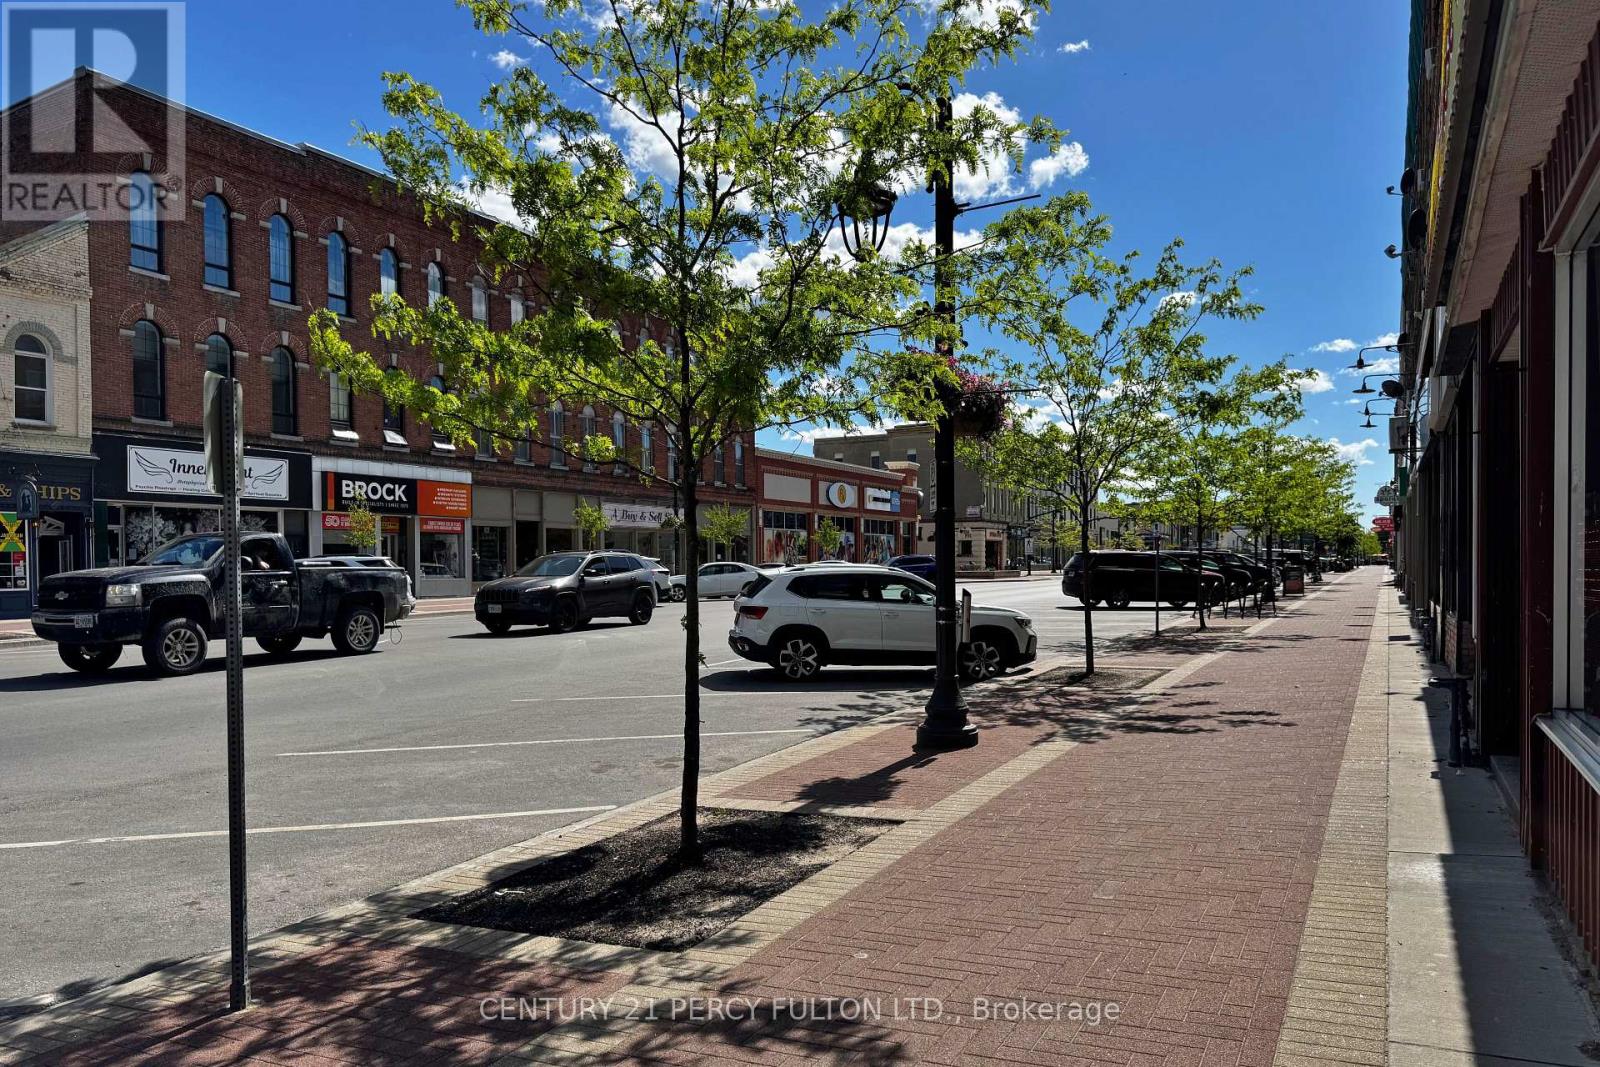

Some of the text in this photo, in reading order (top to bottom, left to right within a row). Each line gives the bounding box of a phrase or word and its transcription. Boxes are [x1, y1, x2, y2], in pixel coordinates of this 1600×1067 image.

[169, 458, 207, 475] Inne
[38, 485, 81, 501] HIPS
[341, 479, 408, 502] BROCK
[622, 509, 638, 522] Buy
[649, 511, 663, 523] Sell
